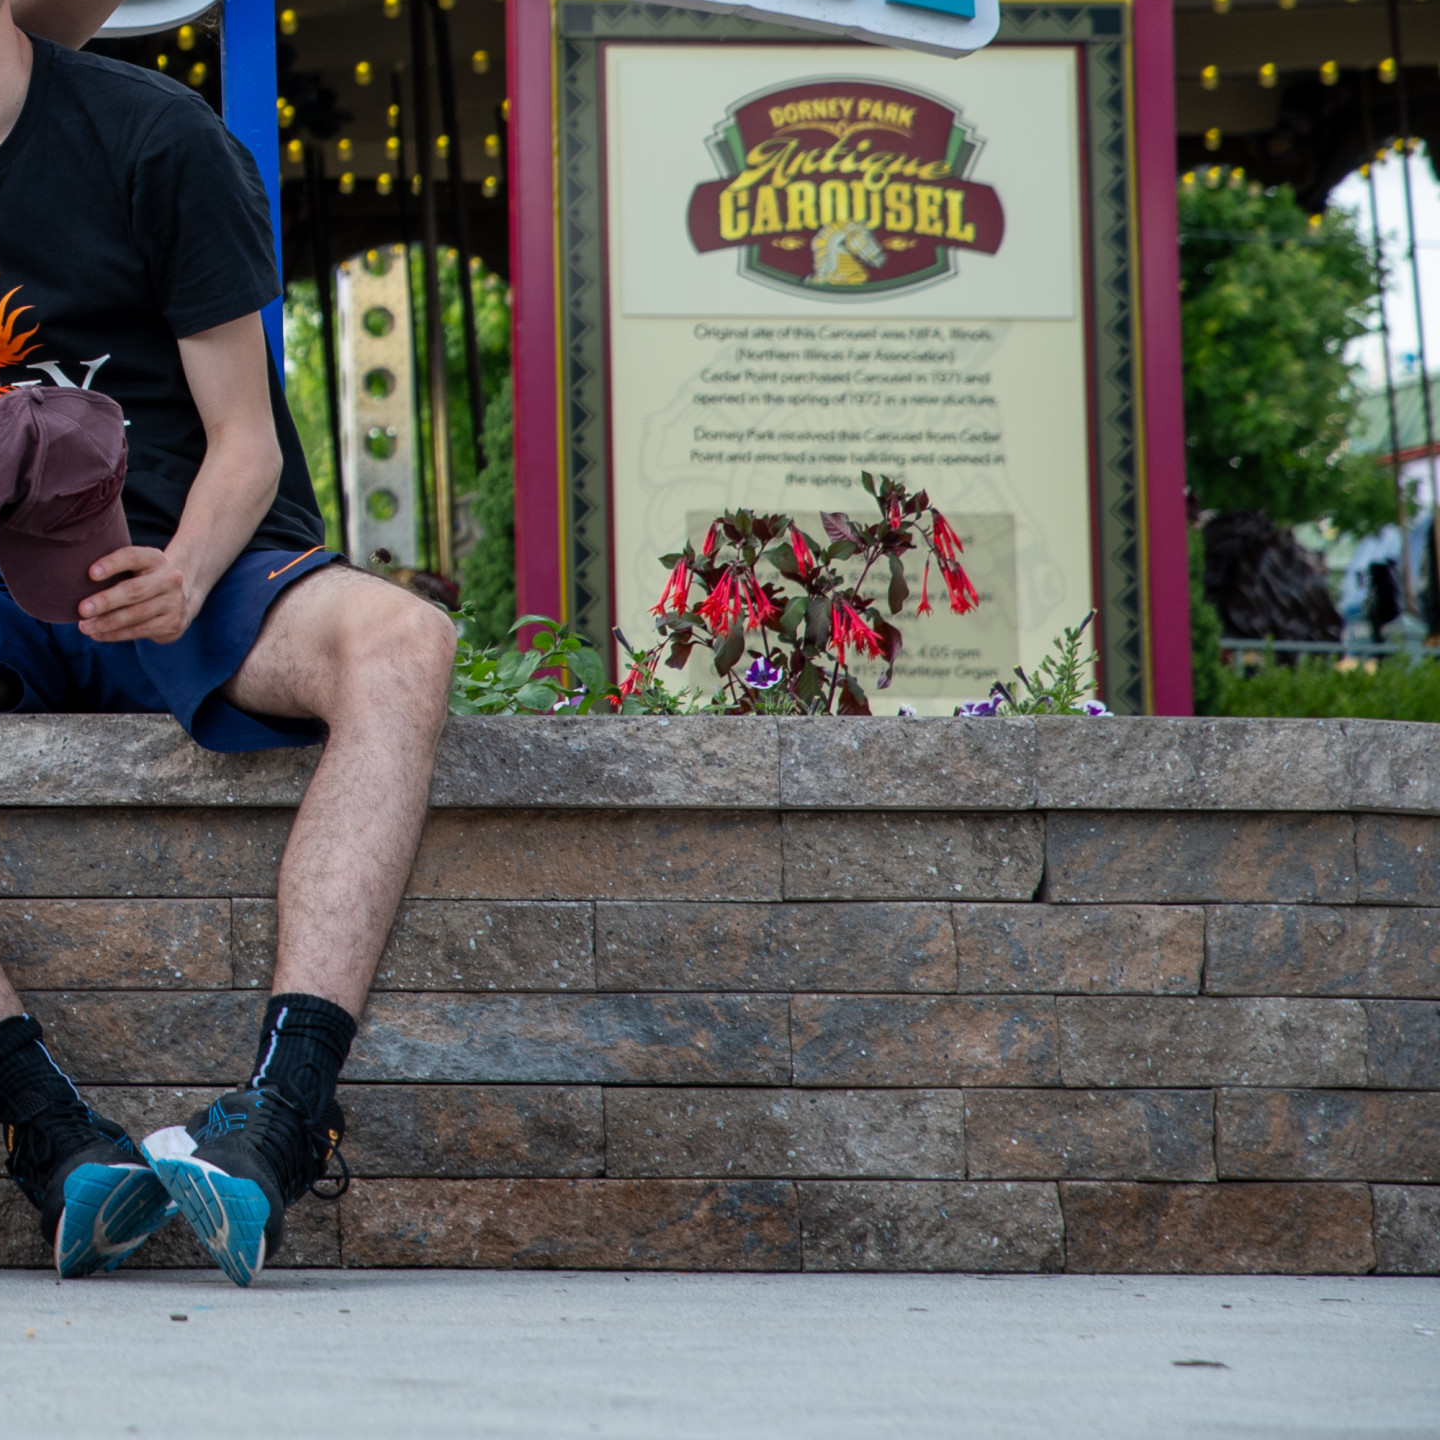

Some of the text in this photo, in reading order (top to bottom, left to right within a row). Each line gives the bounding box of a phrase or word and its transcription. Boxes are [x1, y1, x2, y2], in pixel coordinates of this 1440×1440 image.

[769, 96, 918, 128] DORNEY PARK
[728, 132, 953, 192] Antique
[719, 178, 976, 243] CAROUSEL
